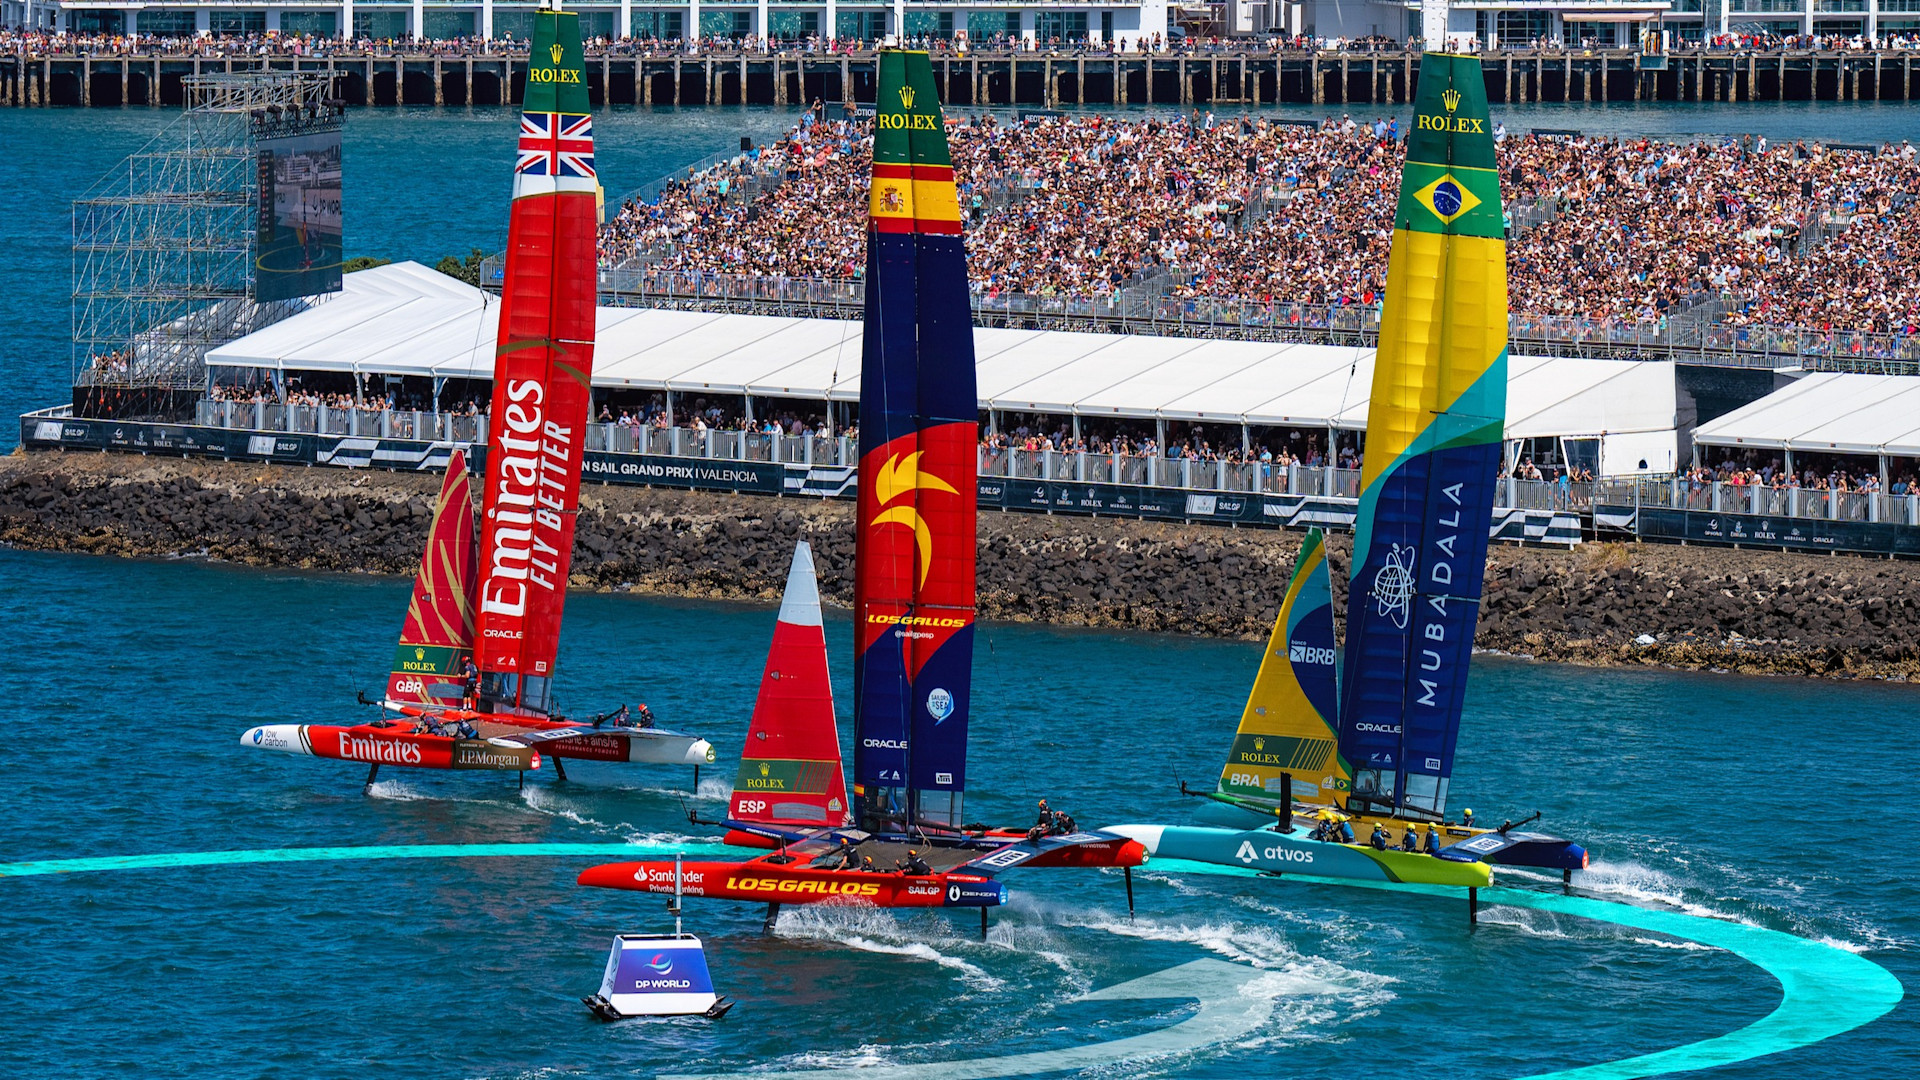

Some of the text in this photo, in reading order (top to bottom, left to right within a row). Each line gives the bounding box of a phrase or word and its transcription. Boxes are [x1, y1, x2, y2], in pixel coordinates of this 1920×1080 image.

[530, 68, 580, 83] ROLEX
[878, 114, 937, 130] ROLEX
[1417, 114, 1484, 133] ROLEX
[591, 461, 619, 474] SAIL
[620, 463, 664, 477] GRAND
[665, 466, 693, 478] PRIX
[700, 468, 758, 483] VALENCIA
[481, 379, 544, 616] Emirates
[1080, 499, 1102, 507] ROLEX
[530, 420, 572, 590] FLY BETTER
[1754, 531, 1776, 539] ROLEX
[1417, 482, 1464, 706] MUBADALA
[483, 629, 523, 639] ORACLE
[895, 630, 934, 639] @sailgpesp
[1305, 647, 1335, 666] BRB
[403, 661, 436, 672] ROLEX
[395, 680, 422, 693] GBR
[935, 701, 948, 710] SEA
[265, 729, 277, 737] low
[1356, 722, 1402, 734] ORACLE
[264, 738, 288, 748] carbon
[339, 731, 421, 764] Emirates
[863, 738, 908, 749] ORACLE
[1241, 752, 1280, 764] ROLEX
[747, 779, 784, 788] ROLEX
[1229, 773, 1260, 787] BRA
[738, 800, 766, 813] ESP
[1264, 846, 1314, 863] atvos
[649, 884, 674, 893] Private
[635, 979, 691, 989] DP WORLD
